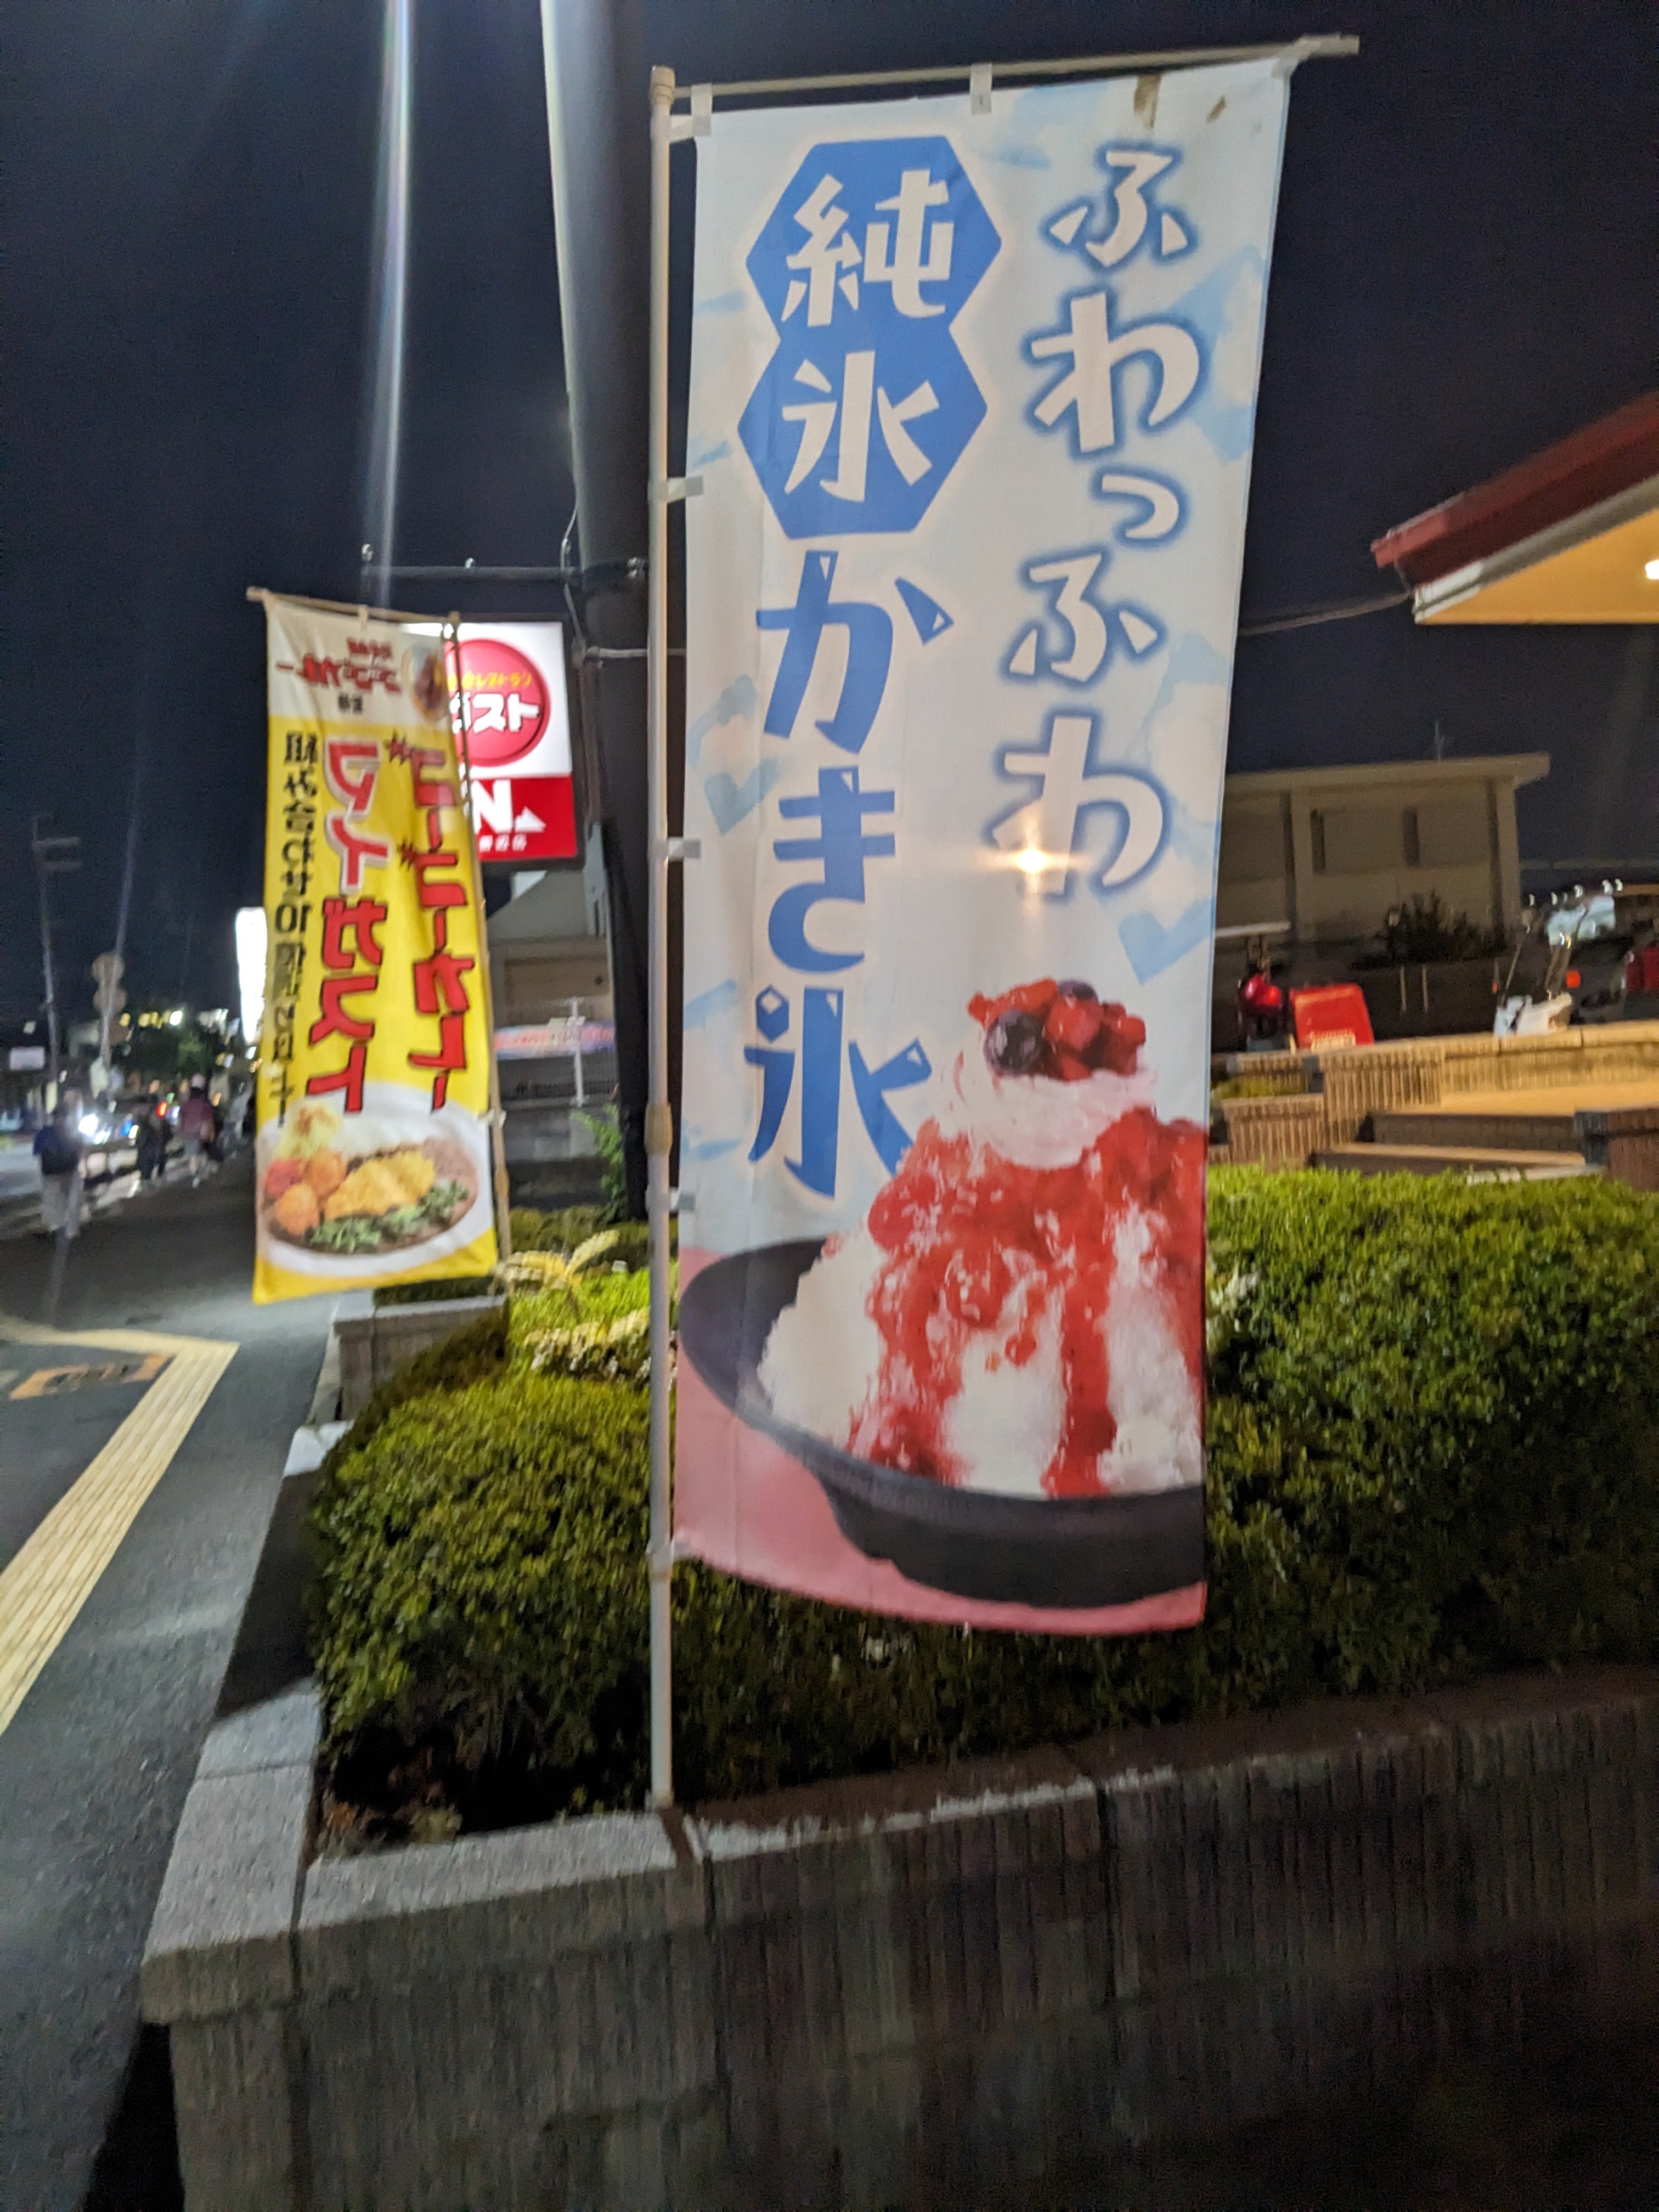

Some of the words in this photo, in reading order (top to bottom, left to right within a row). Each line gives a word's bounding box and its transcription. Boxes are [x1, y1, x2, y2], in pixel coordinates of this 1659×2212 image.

[744, 166, 955, 1200] 純氷かき氷
[989, 146, 1205, 896] ふわっふわ
